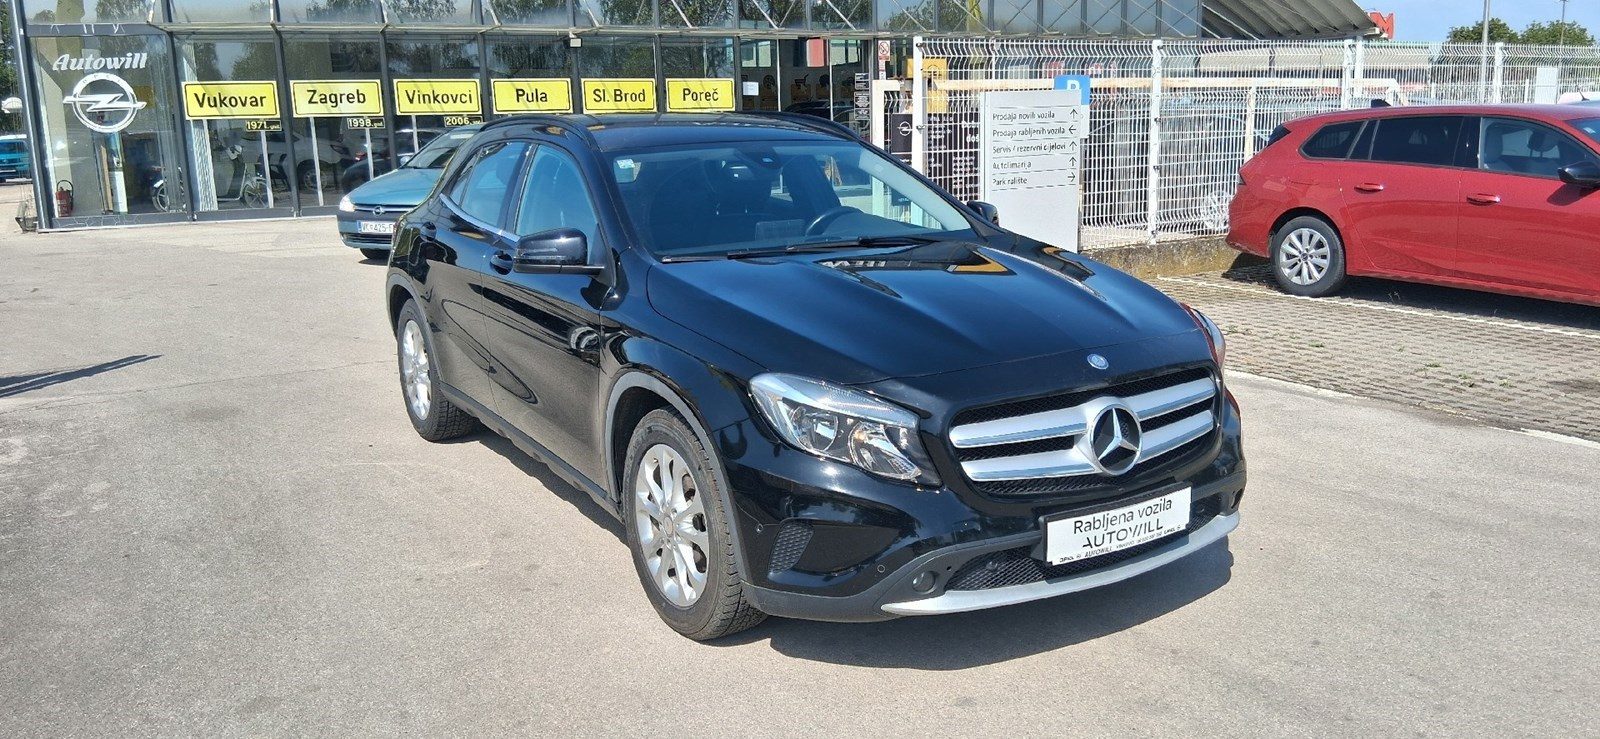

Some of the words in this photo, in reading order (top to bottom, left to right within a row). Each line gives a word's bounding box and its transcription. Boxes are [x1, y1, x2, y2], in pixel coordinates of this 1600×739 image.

[52, 52, 148, 71] Autowill
[193, 92, 266, 108] Vukovar
[306, 89, 366, 108] Zagreb
[405, 89, 473, 104] Vinkovci
[515, 88, 548, 103] Pula
[592, 88, 610, 103] Sl.
[613, 88, 646, 102] Brod
[682, 87, 719, 102] Poreč
[992, 113, 1017, 122] Prodaja
[1018, 111, 1036, 120] novih
[1037, 110, 1055, 119] vozila
[992, 129, 1017, 139] Prodaja
[1018, 127, 1047, 137] rabljenih
[1047, 126, 1066, 135] vozila
[992, 145, 1012, 154] Servis
[1016, 143, 1043, 152] rezervni
[992, 176, 1028, 186] Parkralište
[1073, 510, 1134, 535] Rabljena
[1137, 498, 1173, 519] vozila
